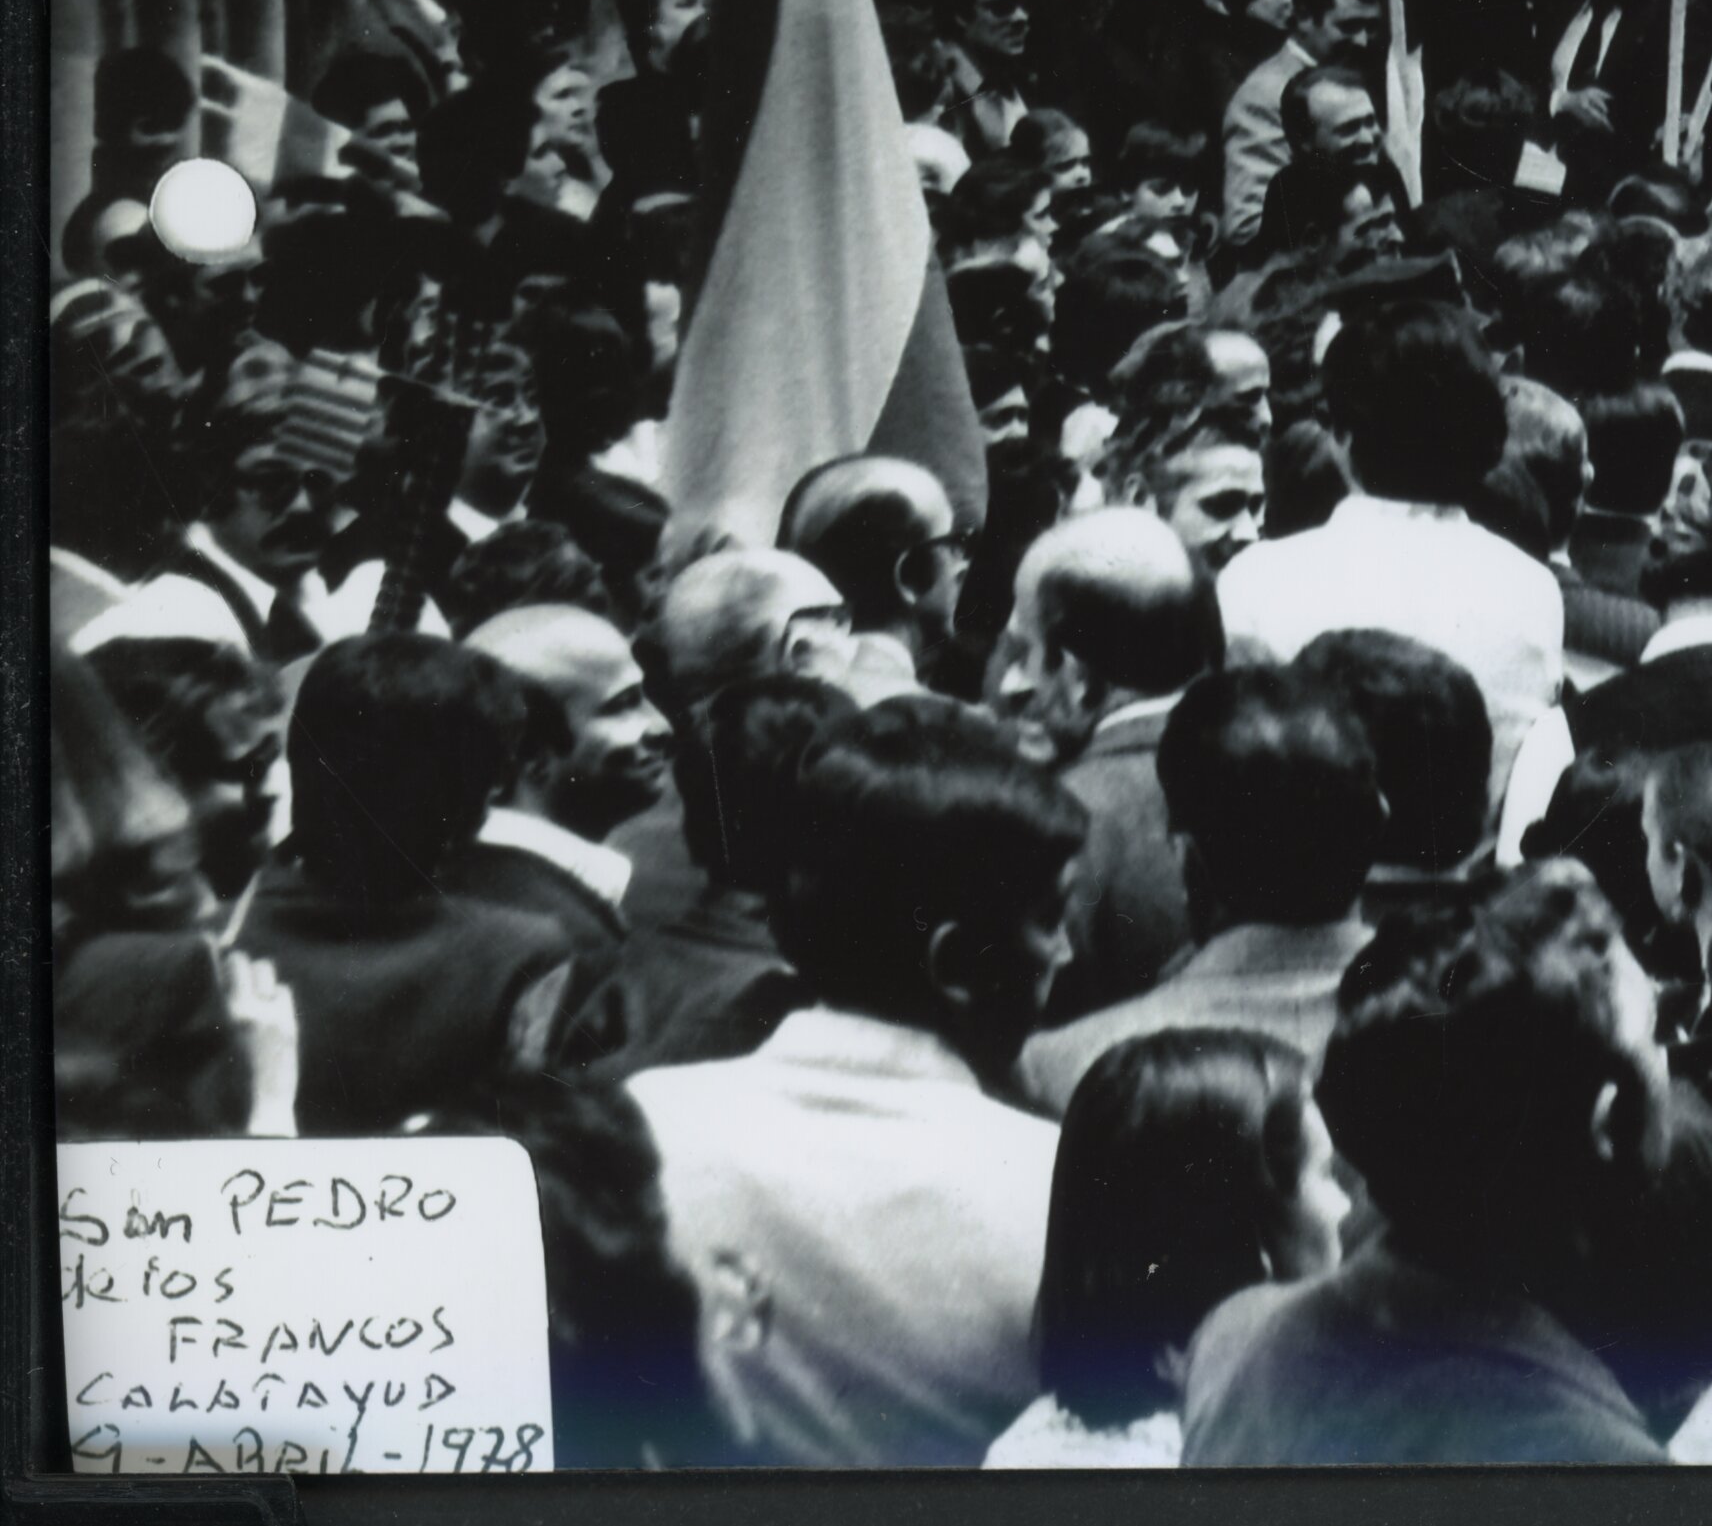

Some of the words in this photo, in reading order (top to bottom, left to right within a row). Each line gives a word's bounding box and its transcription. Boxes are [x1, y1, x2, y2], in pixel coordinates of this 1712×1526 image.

[220, 1168, 457, 1235] PEDRO
[168, 1306, 455, 1364] FRANCOS
[75, 1372, 456, 1431] CALATAYUD
